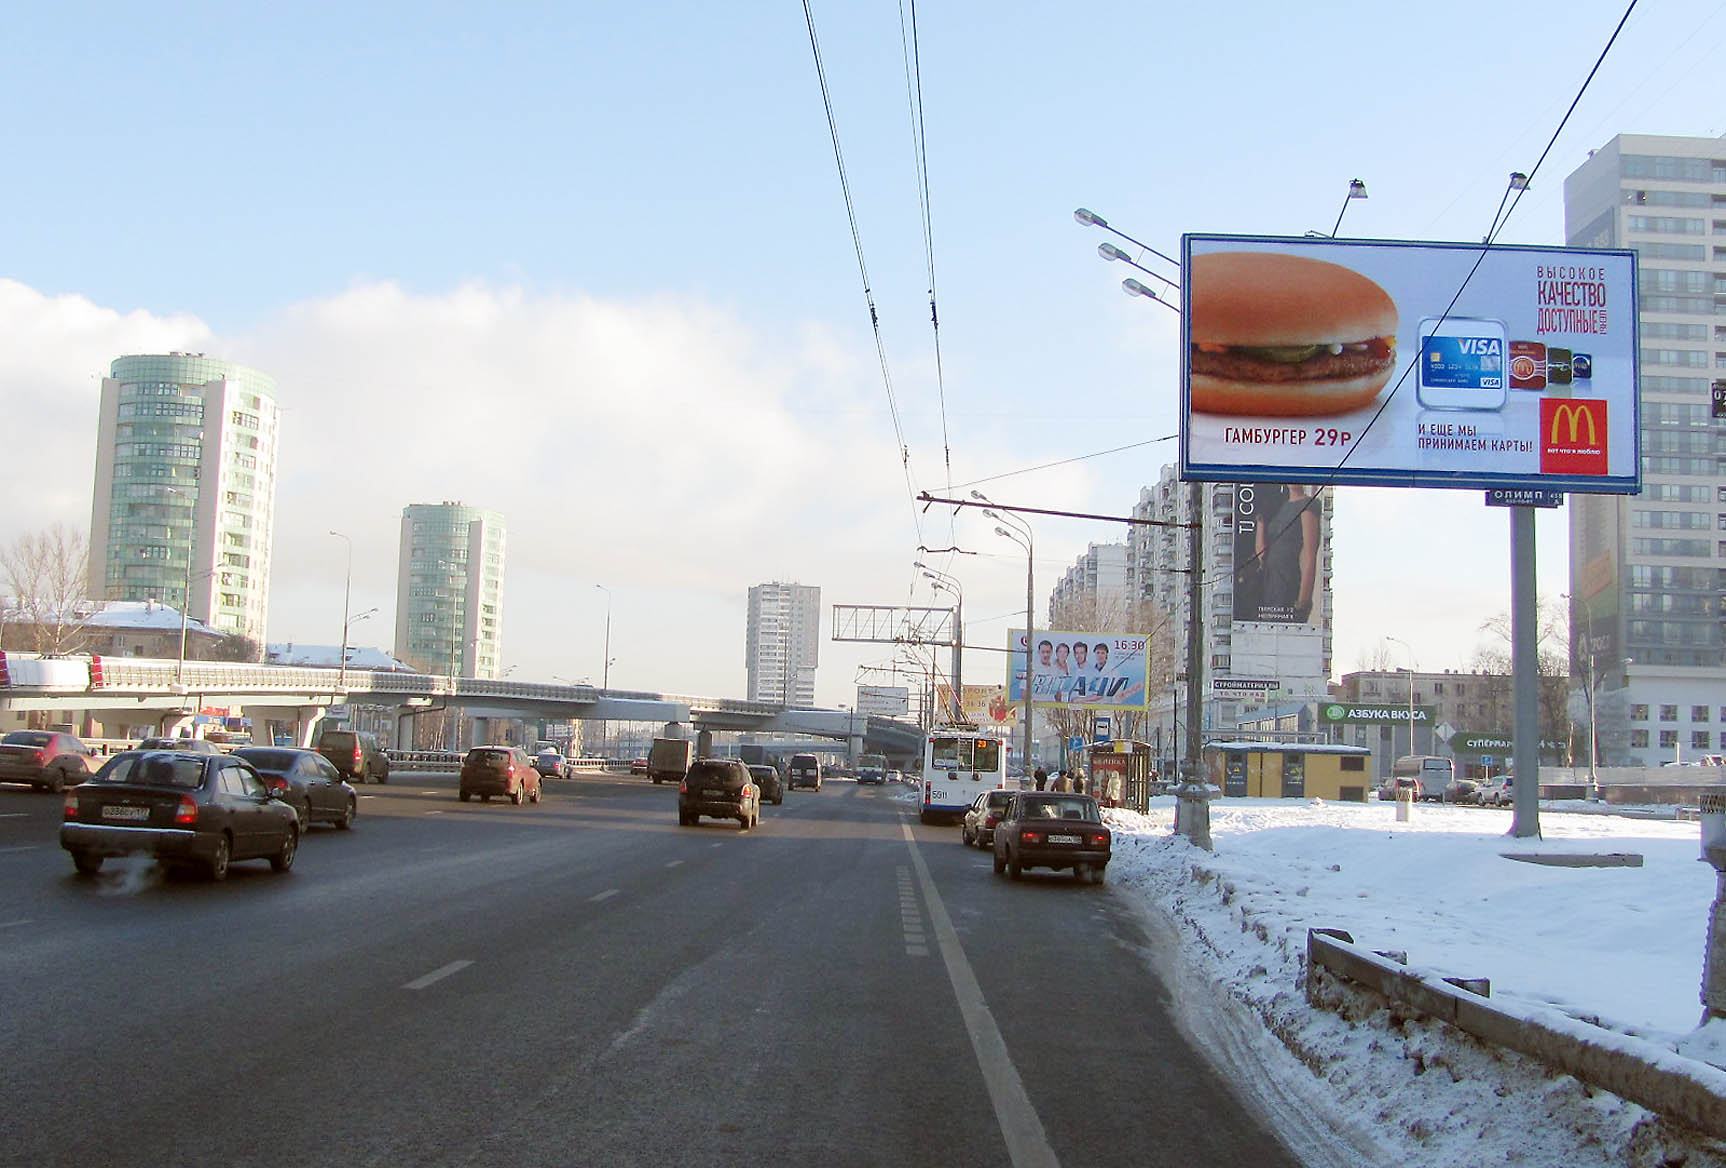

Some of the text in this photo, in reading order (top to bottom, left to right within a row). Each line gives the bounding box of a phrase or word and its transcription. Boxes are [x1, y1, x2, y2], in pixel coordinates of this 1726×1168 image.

[1536, 265, 1605, 281] ВЫСОКОЕ
[1537, 280, 1606, 308] КАЧЕСТВО
[1536, 307, 1598, 336] ДОСТУПНЫЕ
[1457, 338, 1501, 355] VISA
[1481, 378, 1500, 387] VISA
[1225, 427, 1307, 445] ГАМБУРГЕР
[1418, 423, 1477, 438] И ЕЩЕ МЫ
[1418, 437, 1533, 453] ПРИНИМАЕМ КАРТЫ!
[1494, 490, 1543, 499] ОЛИМП
[1239, 520, 1255, 534] TJ
[1114, 640, 1145, 651] 16:30
[1214, 681, 1278, 690] СТРОЙМАТЕРИАЛЫ
[1347, 709, 1427, 720] АЗБУКА ВКУСА
